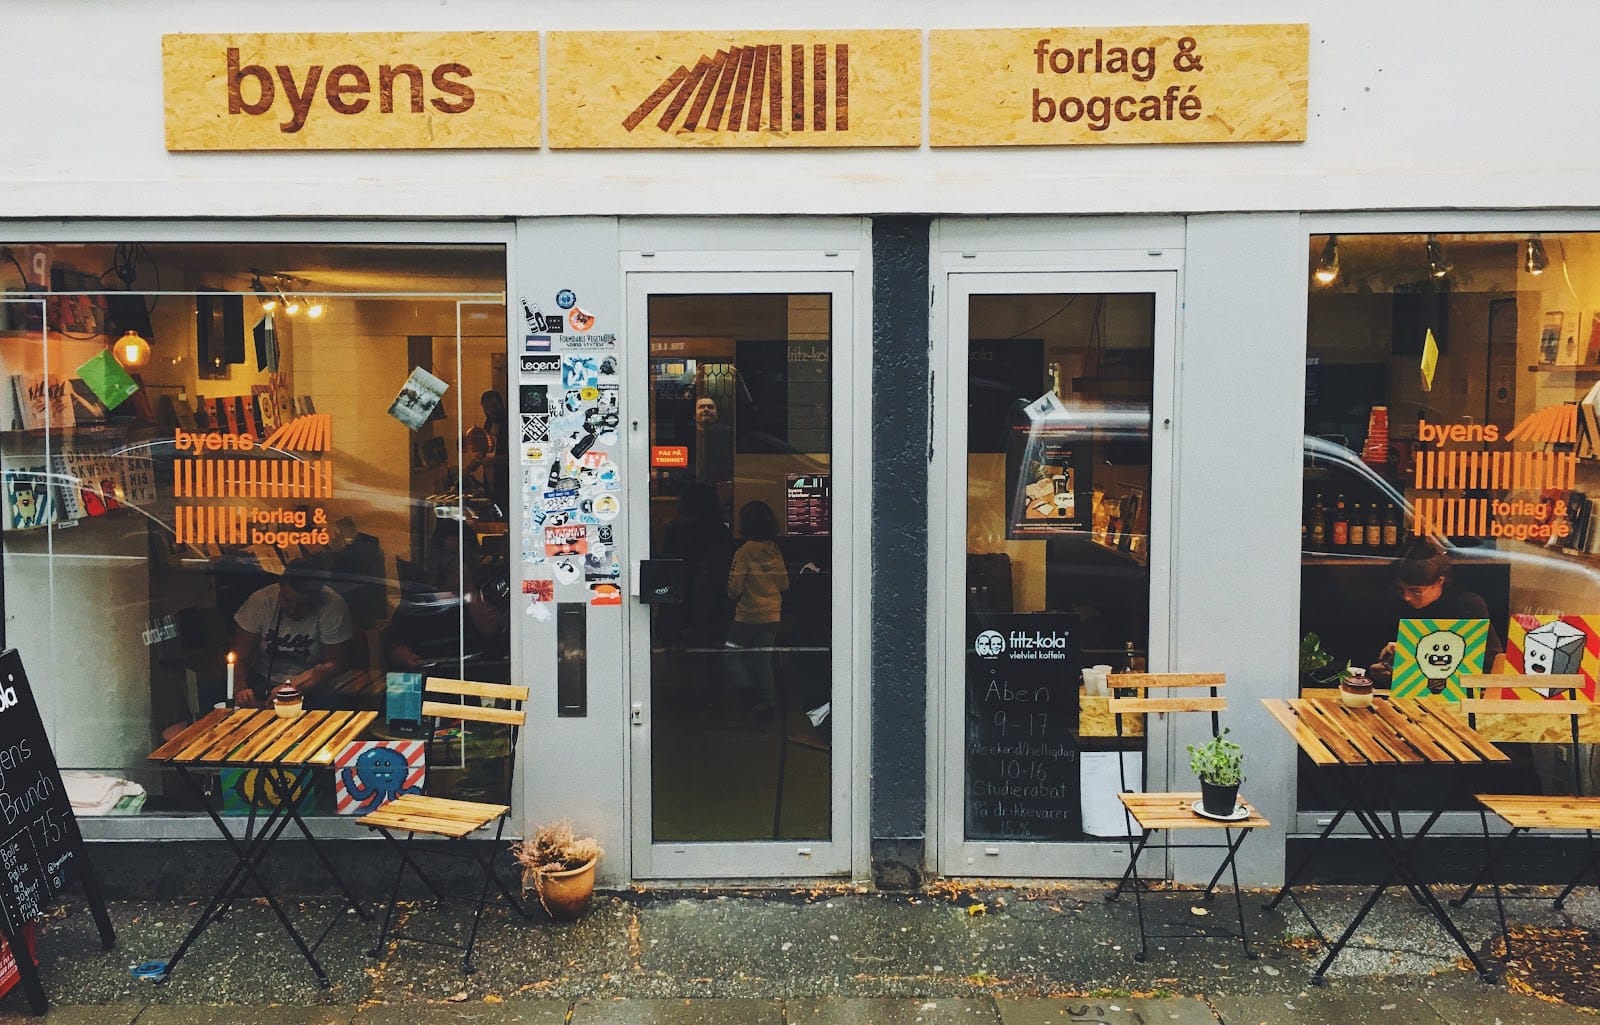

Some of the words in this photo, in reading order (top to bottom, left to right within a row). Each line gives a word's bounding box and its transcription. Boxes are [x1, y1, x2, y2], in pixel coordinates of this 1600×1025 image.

[1033, 38, 1157, 82] forlag
[1172, 36, 1204, 73] &
[226, 47, 476, 134] byens
[1031, 85, 1203, 132] bogcafé
[521, 359, 560, 374] Legend
[175, 427, 254, 455] byens
[1419, 419, 1499, 448] byens
[252, 508, 306, 527] forlag
[313, 508, 327, 524] &
[1491, 500, 1548, 520] forlag
[1554, 500, 1568, 516] &
[252, 528, 330, 548] bogcafé
[1490, 519, 1570, 540] bogcafé
[1009, 630, 1066, 649] fritz-kola
[1009, 651, 1037, 660] vielviel
[1038, 651, 1066, 660] koffein
[984, 668, 1051, 703] Åben
[0, 770, 54, 825] Brunch
